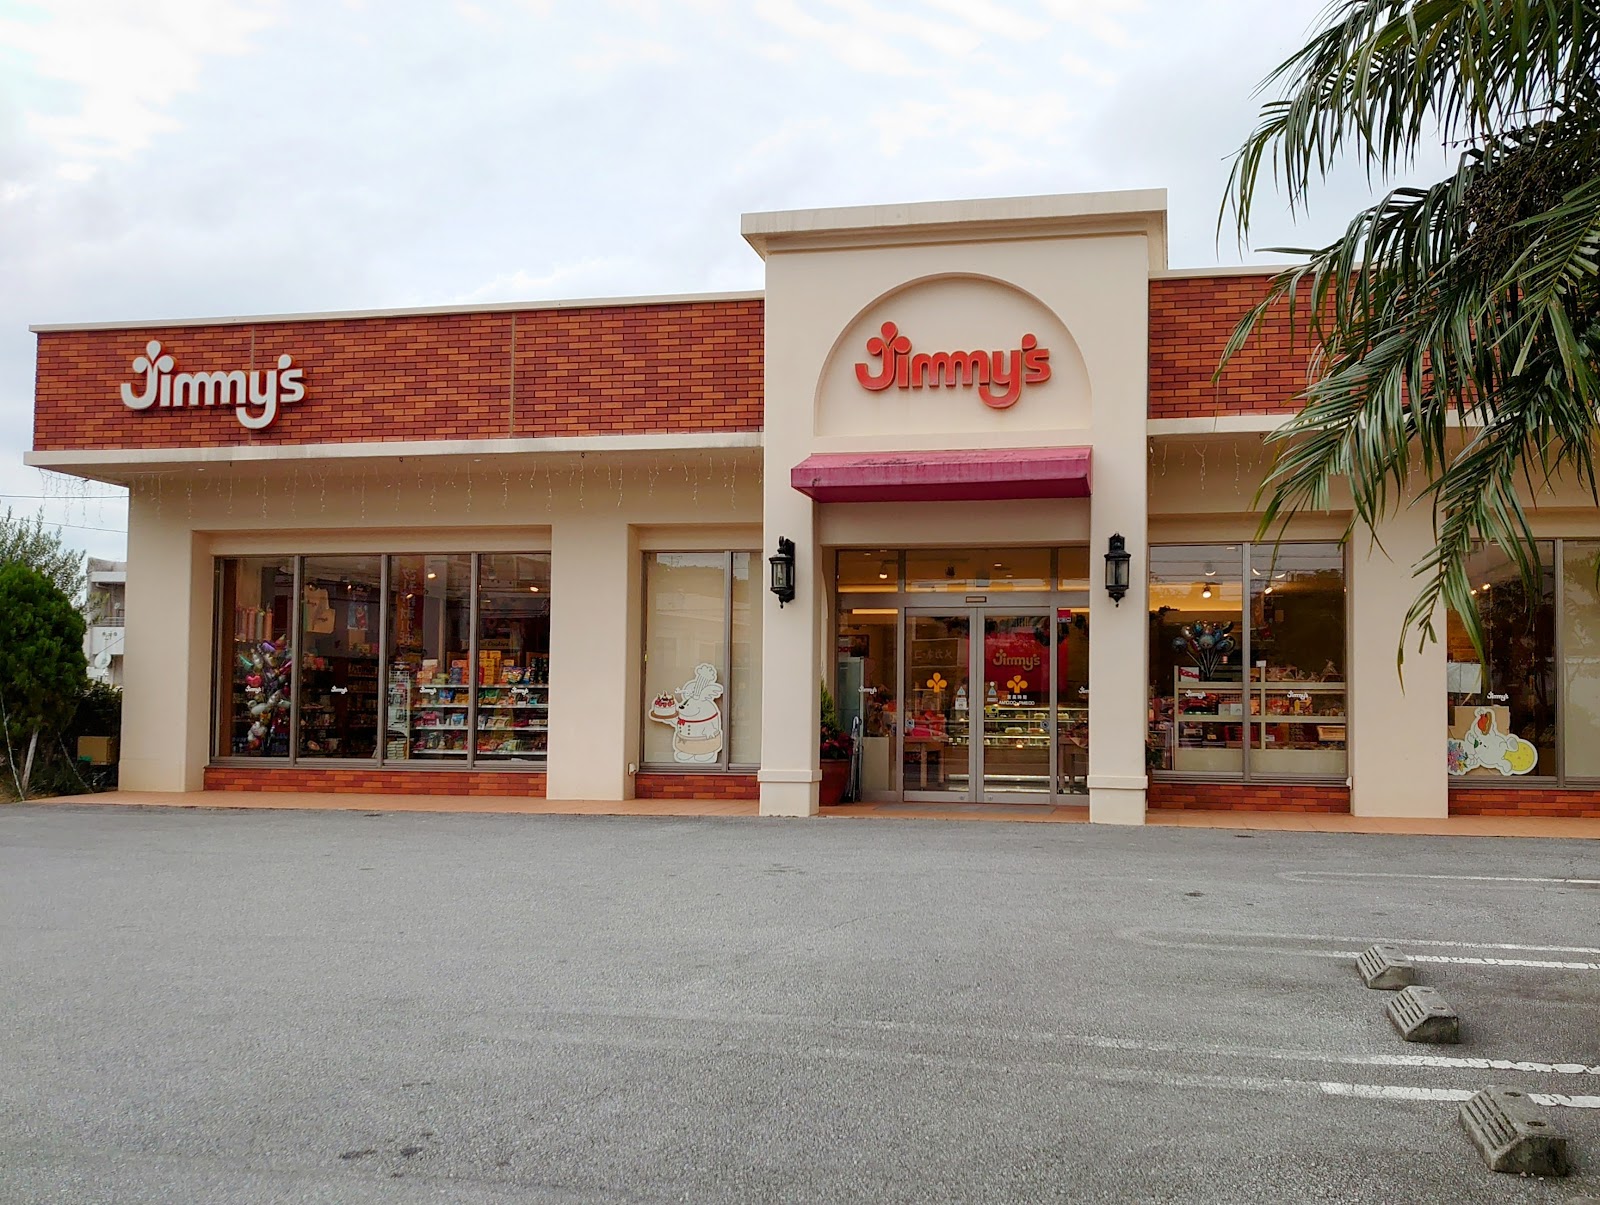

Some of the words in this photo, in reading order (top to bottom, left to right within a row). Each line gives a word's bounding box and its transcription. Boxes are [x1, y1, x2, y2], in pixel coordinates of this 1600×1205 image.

[120, 340, 305, 429] Jimmy's
[855, 321, 1051, 408] Jimmy's
[992, 649, 1040, 671] Jimmy's
